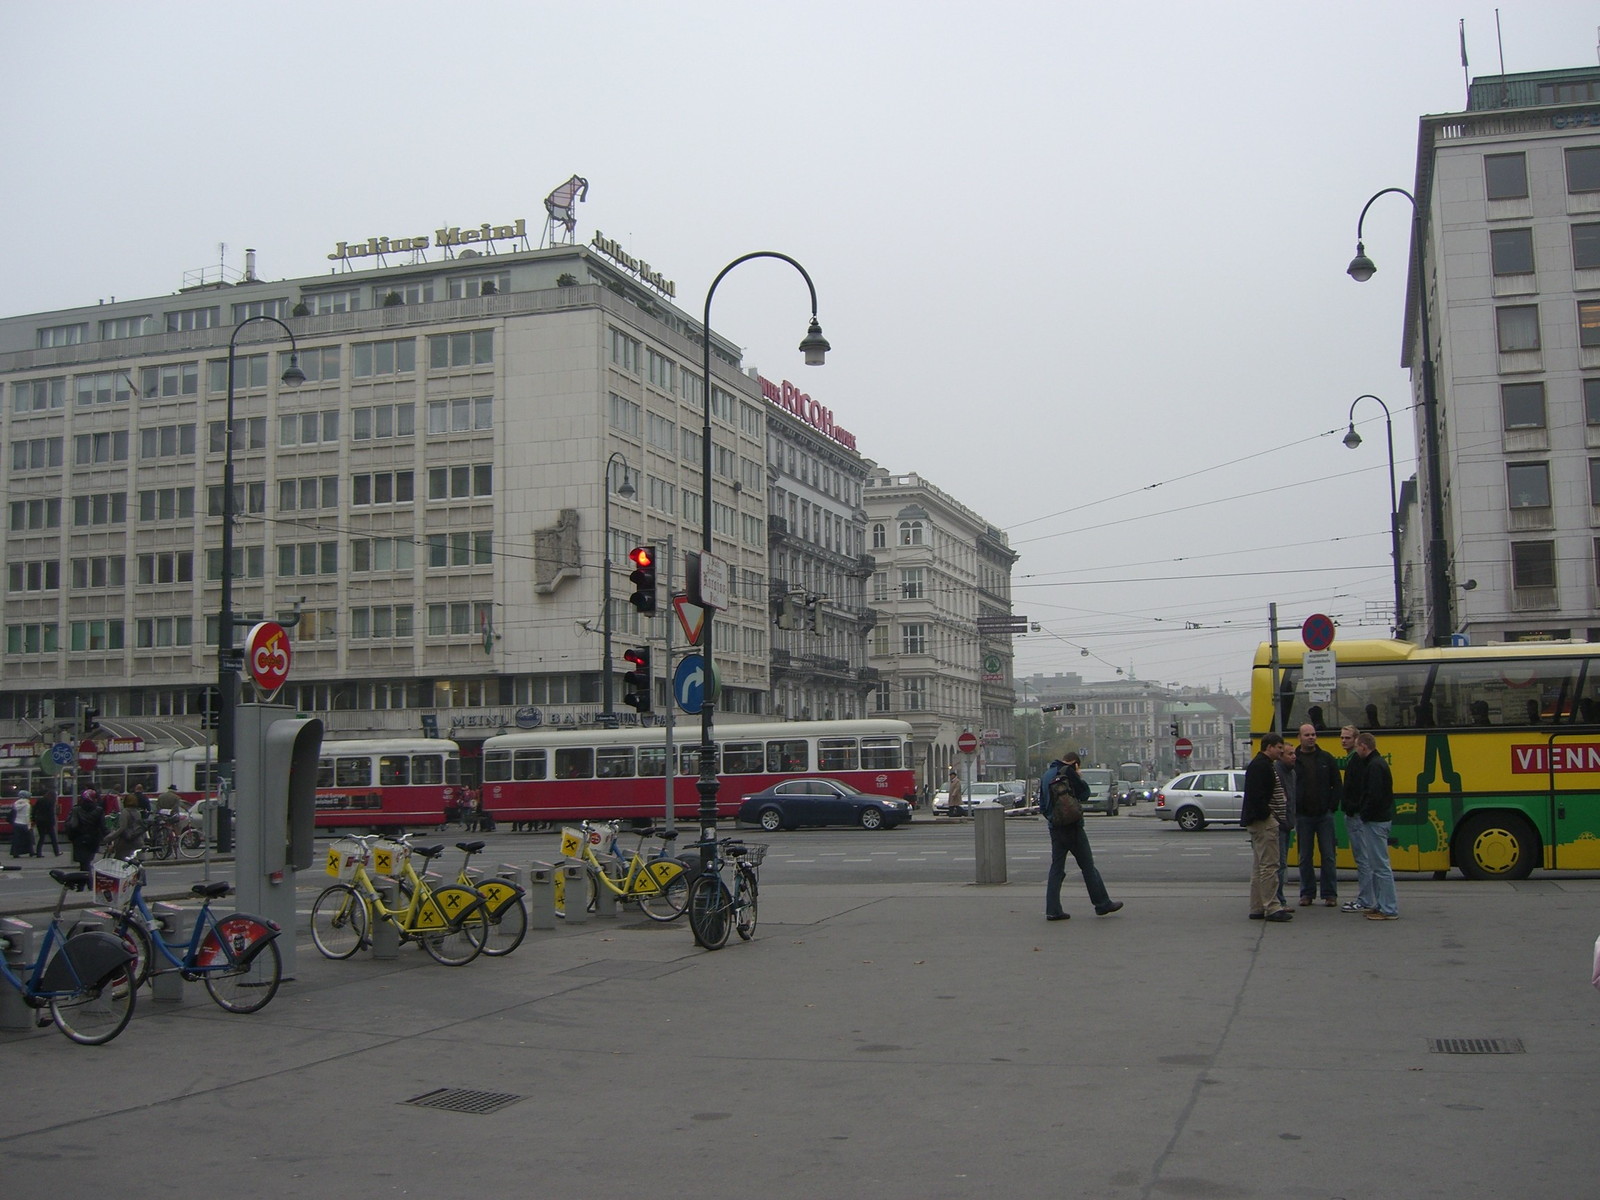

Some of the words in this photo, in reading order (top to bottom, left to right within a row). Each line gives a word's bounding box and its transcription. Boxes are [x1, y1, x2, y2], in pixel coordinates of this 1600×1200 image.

[327, 236, 430, 260] Julius
[435, 219, 527, 247] Meinl
[592, 229, 639, 272] Julius
[639, 259, 676, 298] Meinl
[782, 379, 834, 437] RICOH
[452, 713, 509, 728] MEINL
[1516, 747, 1600, 770] VIENN
